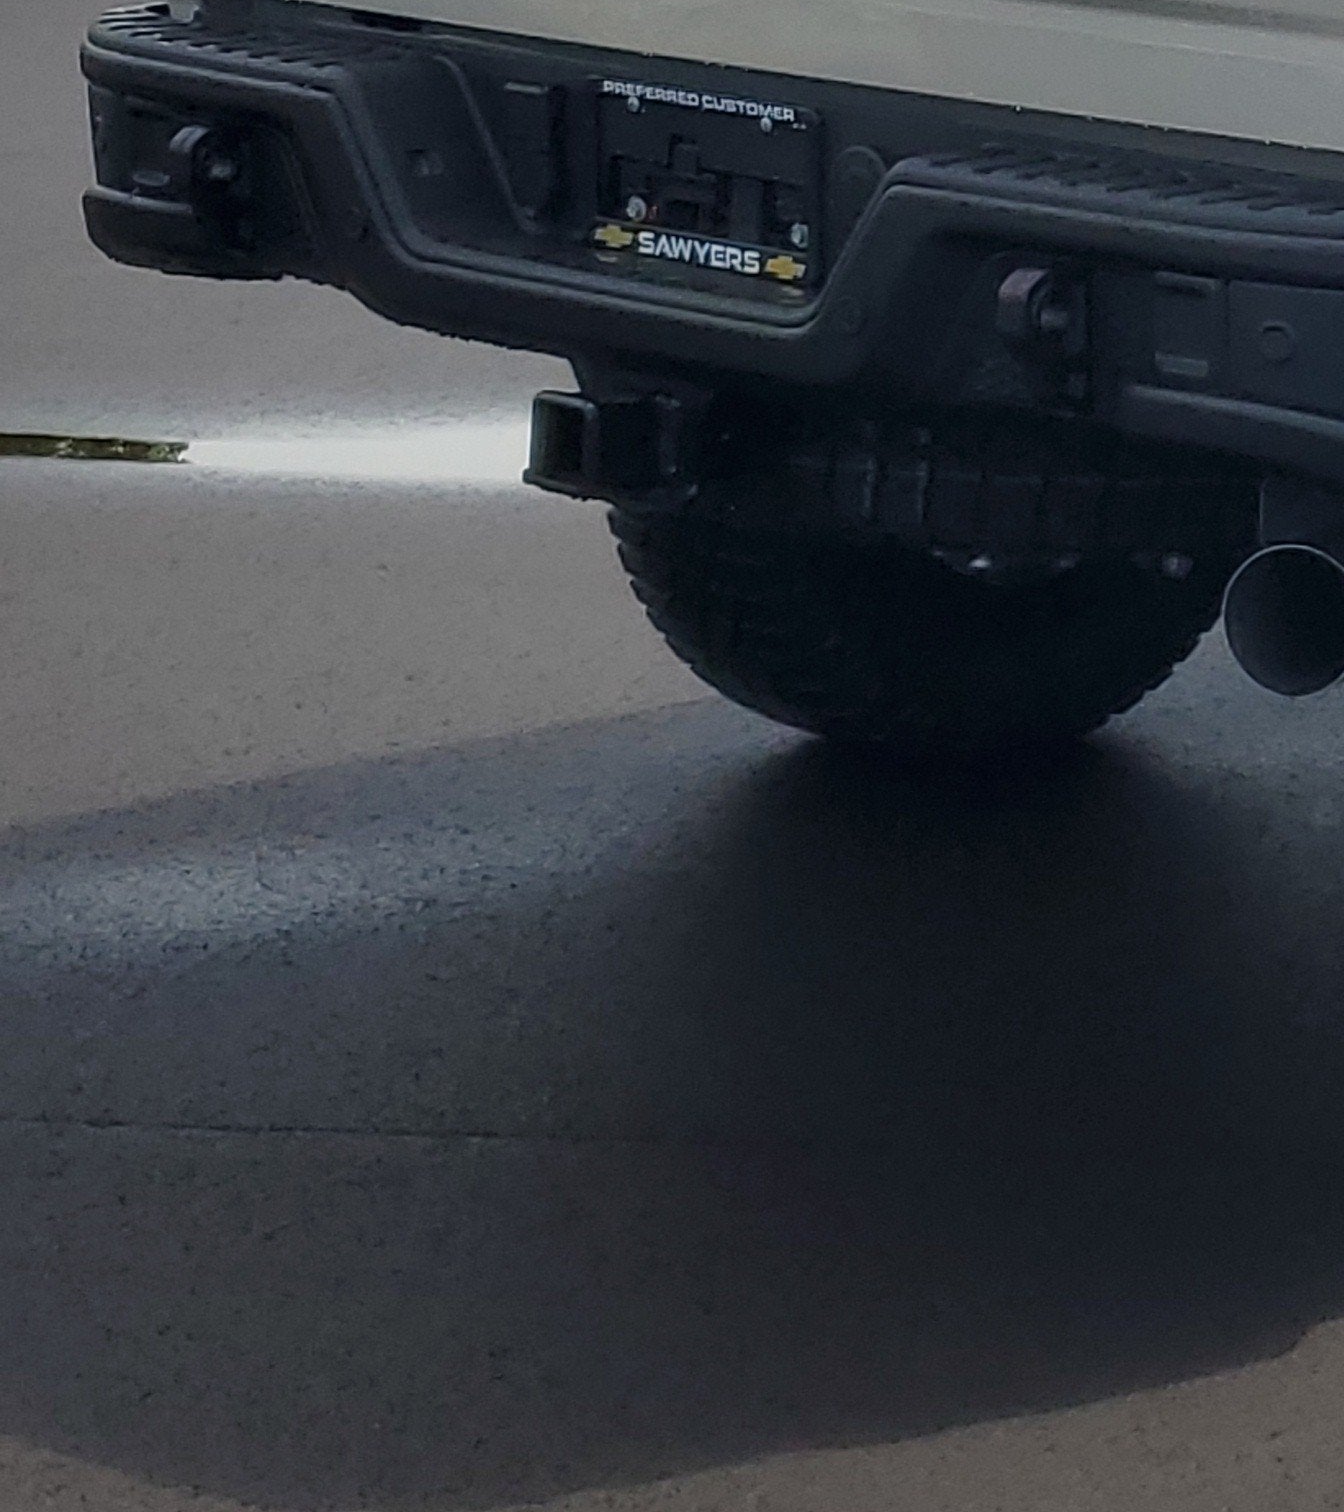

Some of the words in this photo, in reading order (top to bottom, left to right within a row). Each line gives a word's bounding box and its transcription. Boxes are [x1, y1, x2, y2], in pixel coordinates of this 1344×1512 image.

[602, 79, 700, 107] PREFERRED
[701, 94, 795, 122] CUSTOMER
[637, 230, 762, 275] SAWYERS
